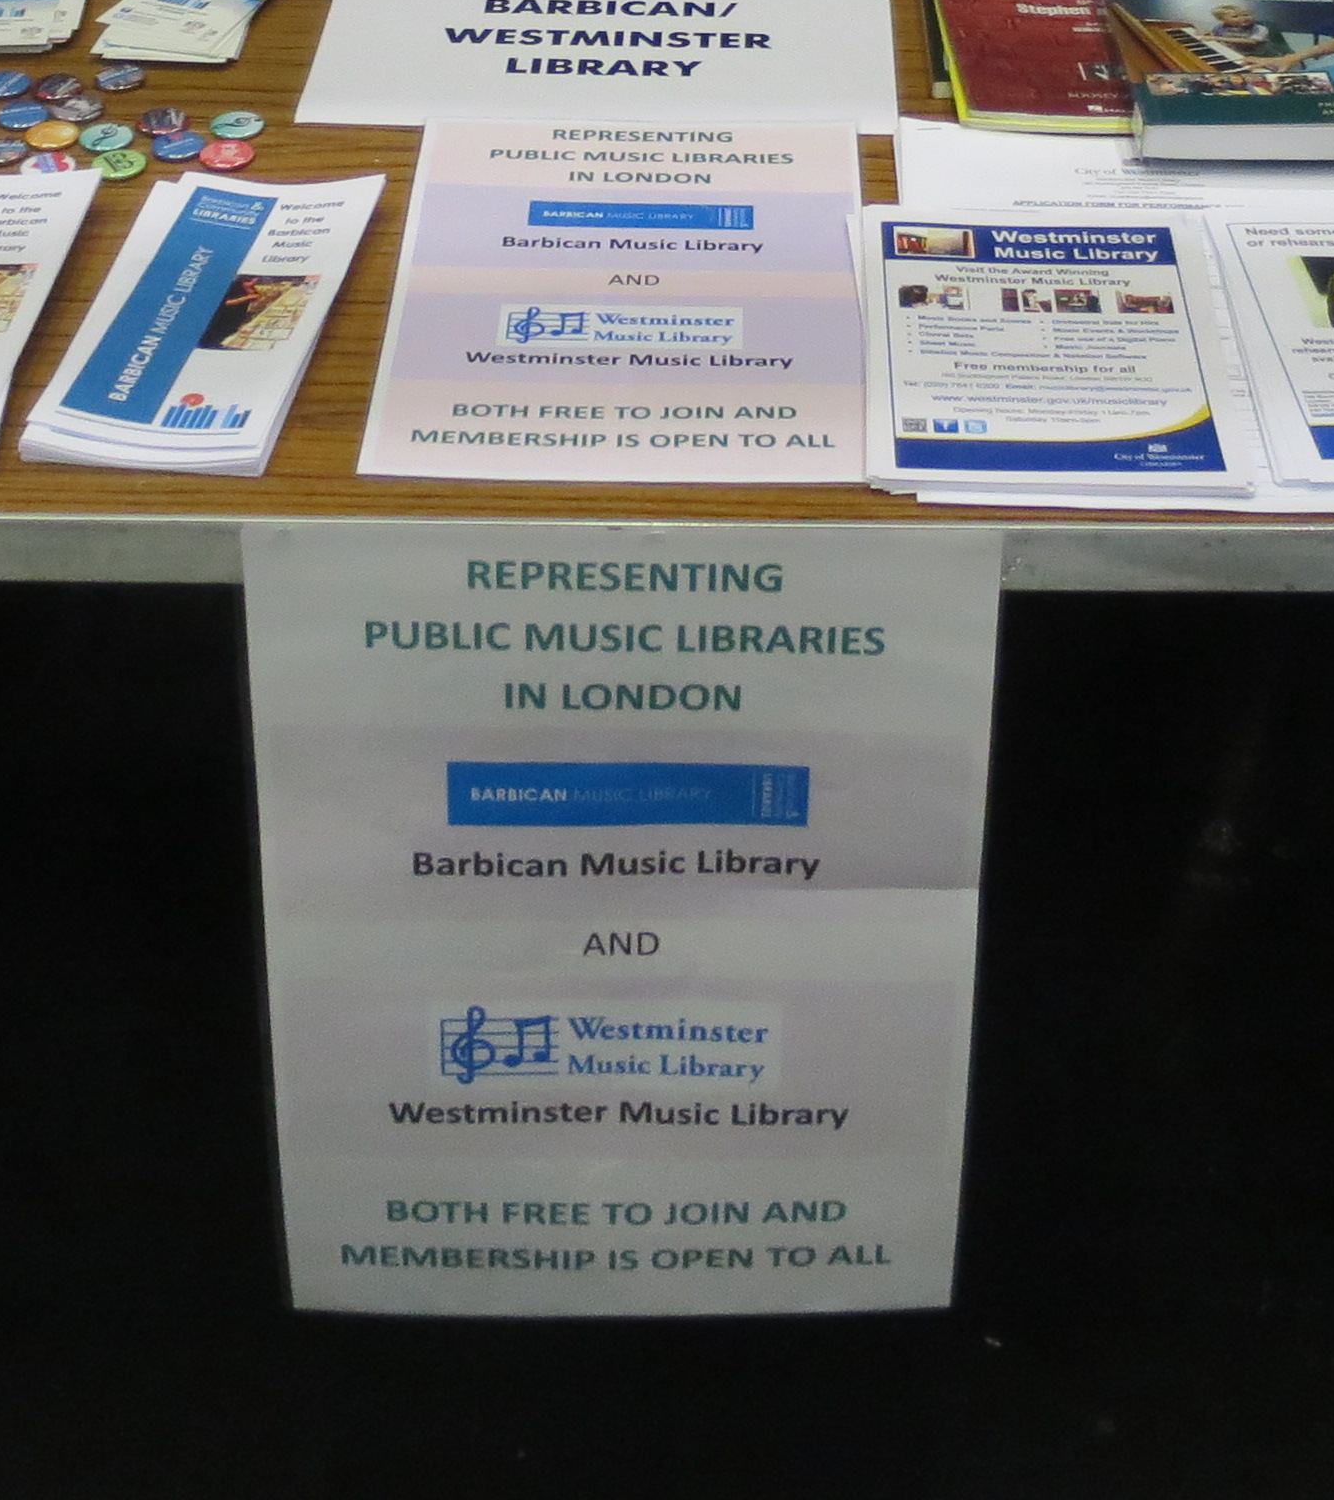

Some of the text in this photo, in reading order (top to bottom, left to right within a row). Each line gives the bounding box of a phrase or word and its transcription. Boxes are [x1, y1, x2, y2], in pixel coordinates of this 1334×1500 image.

[1016, 3, 1091, 16] Stephen
[445, 27, 769, 48] WESTMINSTER
[506, 57, 700, 76] LIBRARY
[553, 129, 732, 142] REPRESENTING
[489, 148, 793, 164] PUBLIC MUSIC LIBRARIES
[569, 171, 710, 183] IN LONDON
[279, 201, 344, 210] Welcome
[267, 228, 330, 236] Barbican
[991, 230, 1155, 245] Westminster
[1245, 227, 1289, 235] Need
[502, 236, 763, 253] Barbican Music Library
[994, 246, 1157, 262] Music Library
[608, 274, 659, 285] AND
[108, 245, 213, 401] BARBICAN MUSIC LIBRARY
[596, 313, 733, 326] Westminster
[594, 330, 731, 345] Music Library
[466, 351, 792, 369] Westminster Music Library
[452, 403, 796, 419] BOTH FREE TO JOIN AND
[411, 429, 834, 447] MEMBERSHIP IS OPEN TO ALL
[467, 560, 782, 592] REPRESENTING
[365, 621, 884, 655] PUBLIC MUSIC LIBRARIES
[505, 682, 740, 711] IN LONDON
[470, 787, 566, 801] BARBICAN
[413, 848, 819, 880] Barbican Music Library
[583, 931, 659, 955] AND
[568, 1016, 767, 1043] Westminster
[567, 1054, 764, 1083] Music Library
[388, 1101, 848, 1129] Westminster Music Library
[386, 1200, 846, 1225] BOTH FREE TO JOIN AND
[341, 1244, 889, 1270] MEMBERSHIP IS OPEN TO ALL
